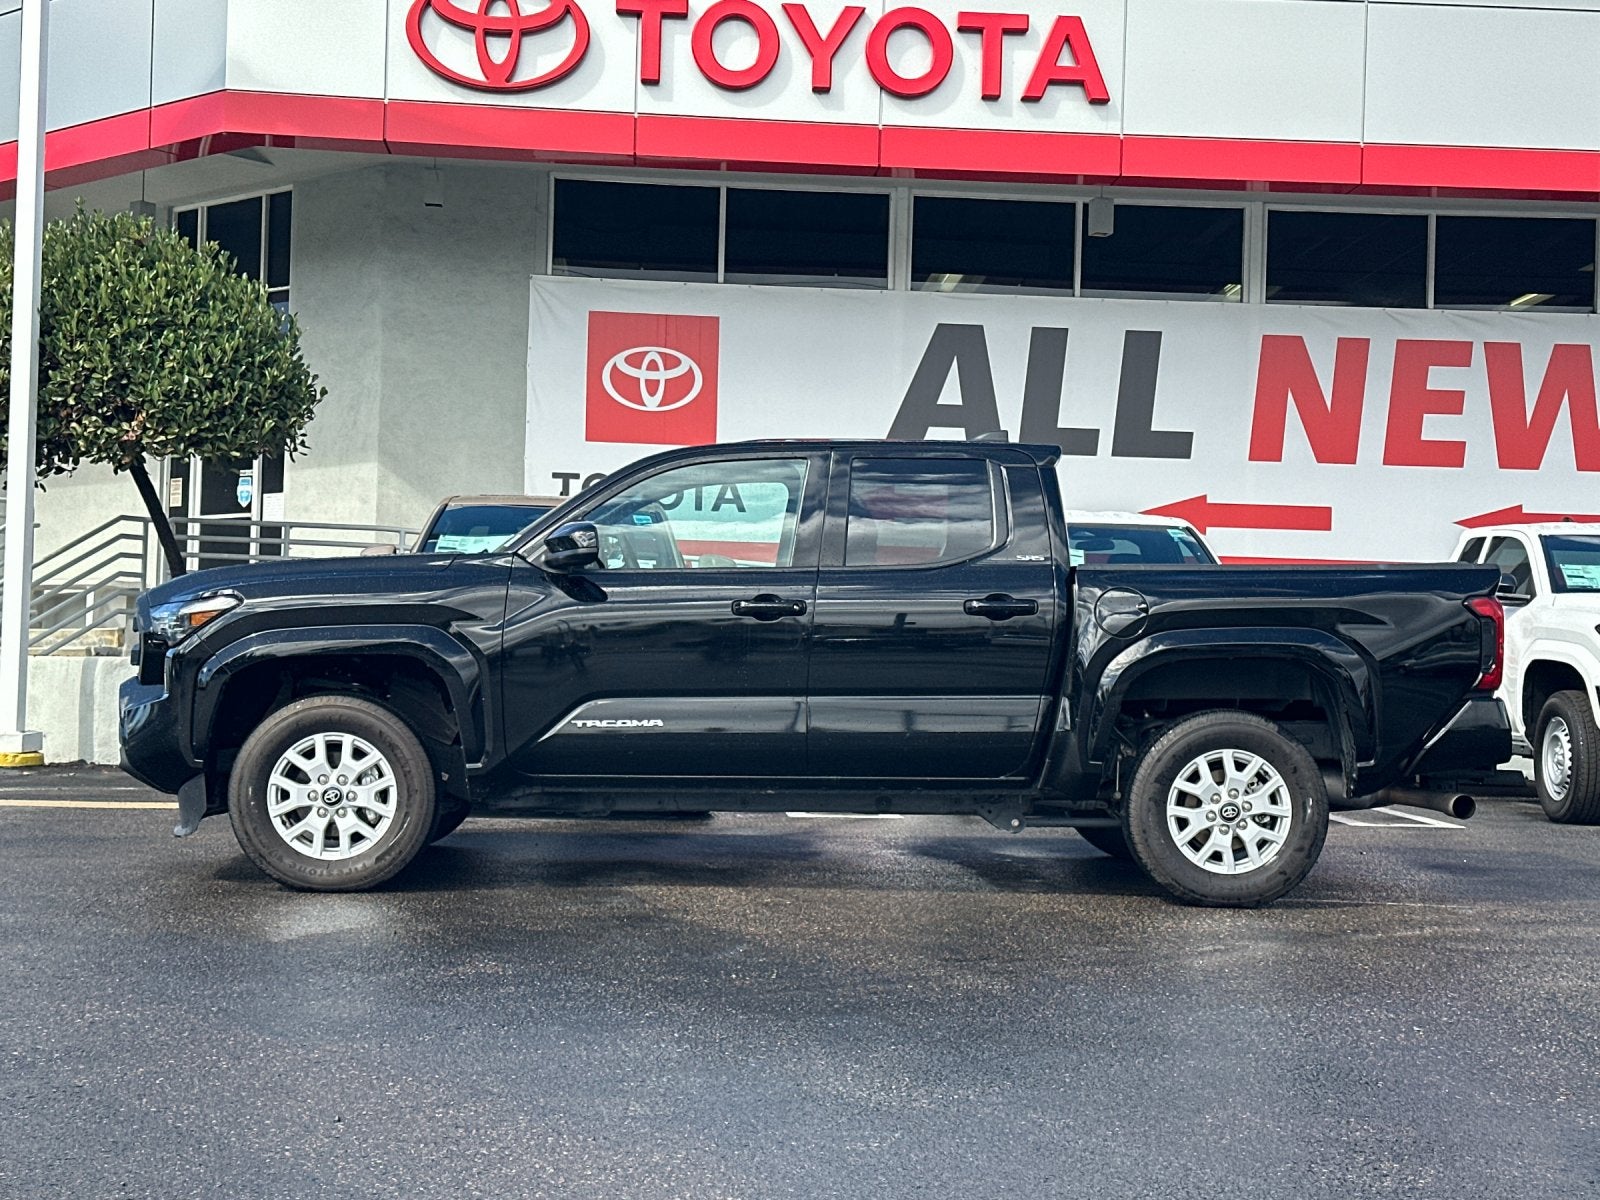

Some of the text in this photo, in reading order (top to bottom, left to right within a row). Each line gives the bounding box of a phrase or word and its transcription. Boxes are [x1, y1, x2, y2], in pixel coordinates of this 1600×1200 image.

[616, 0, 1110, 104] TOYOTA
[886, 323, 1600, 472] ALL NEW
[570, 719, 664, 728] TACOMA
